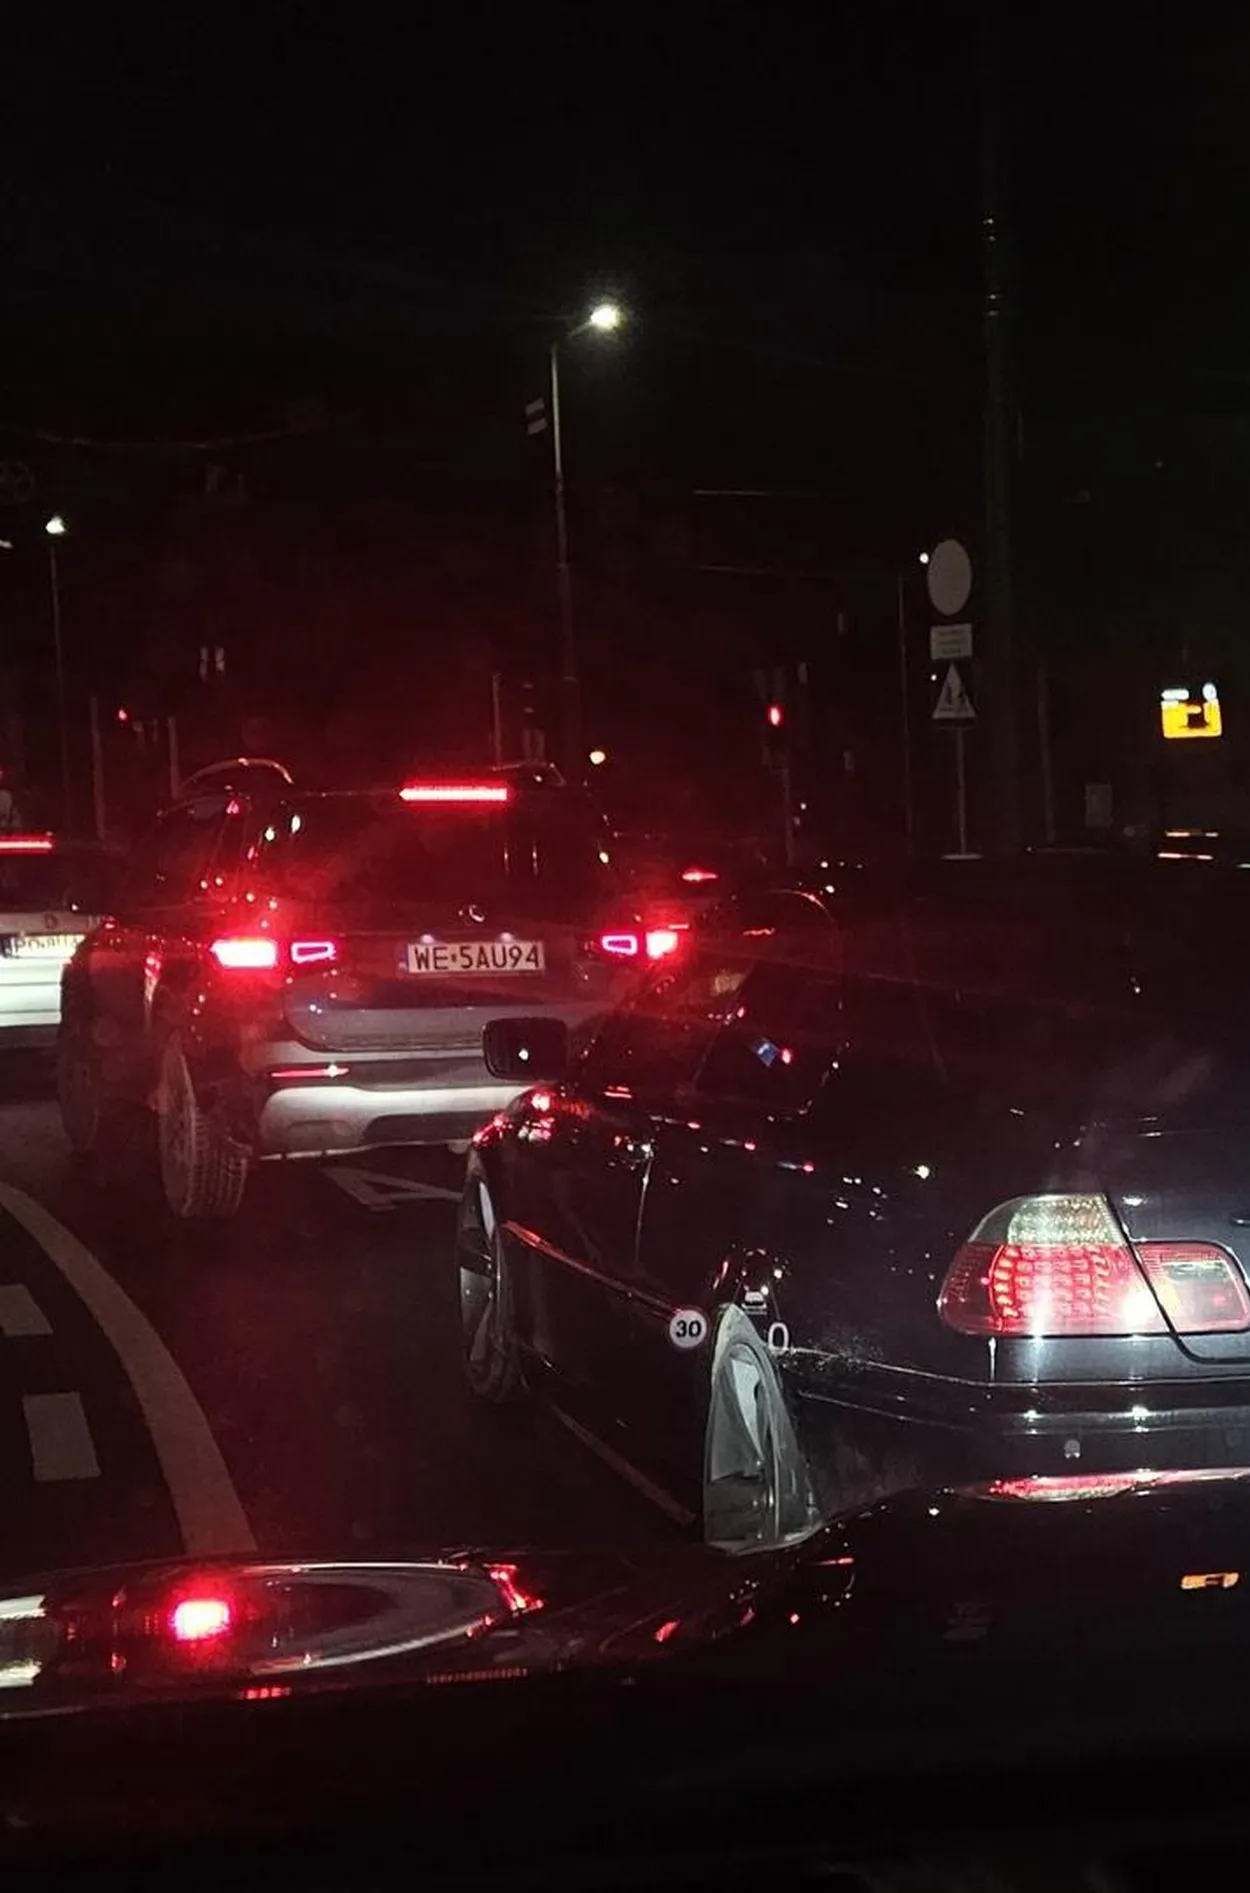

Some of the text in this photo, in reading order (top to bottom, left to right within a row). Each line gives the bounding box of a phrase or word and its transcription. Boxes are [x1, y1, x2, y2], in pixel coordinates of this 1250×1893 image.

[414, 945, 540, 971] WE 5AU94
[675, 1319, 702, 1338] 30
